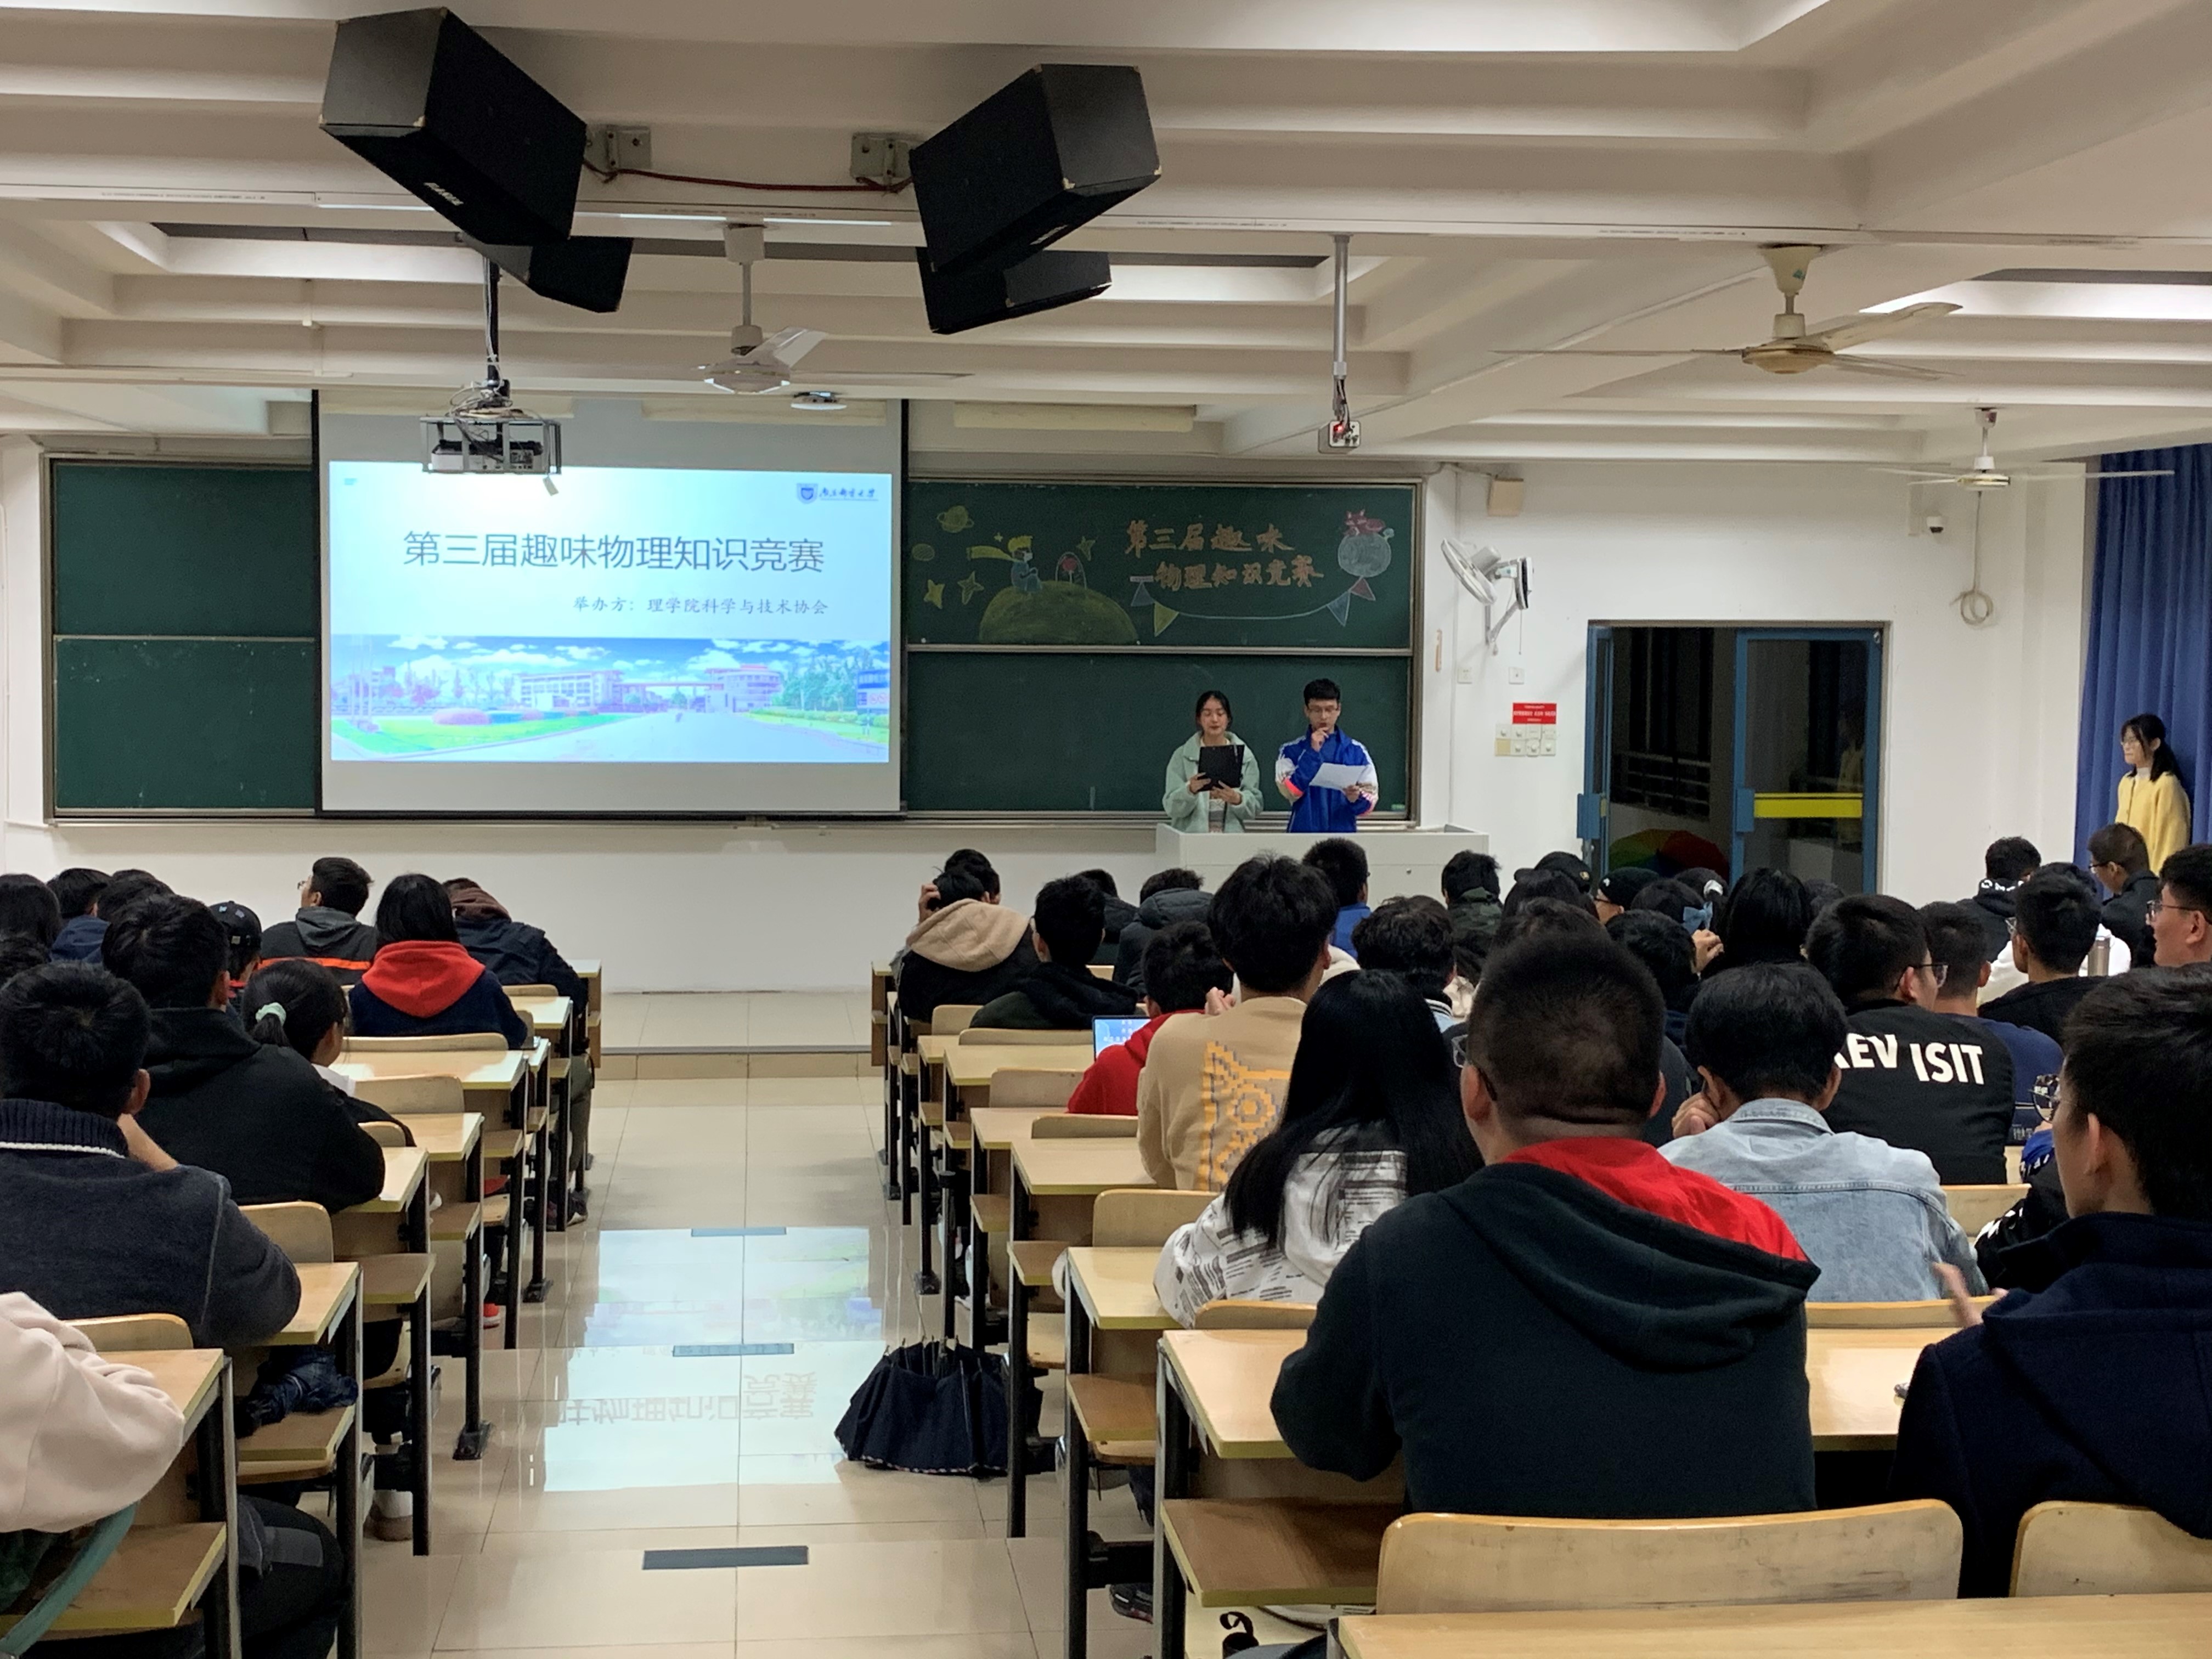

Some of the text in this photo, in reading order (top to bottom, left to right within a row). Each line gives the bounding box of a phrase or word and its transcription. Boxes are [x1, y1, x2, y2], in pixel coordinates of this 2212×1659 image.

[403, 531, 825, 573] 第三届趣味物理知识竞赛
[1125, 520, 1295, 558] 第三届趣味
[1154, 555, 1324, 591] 物理知识竞赛
